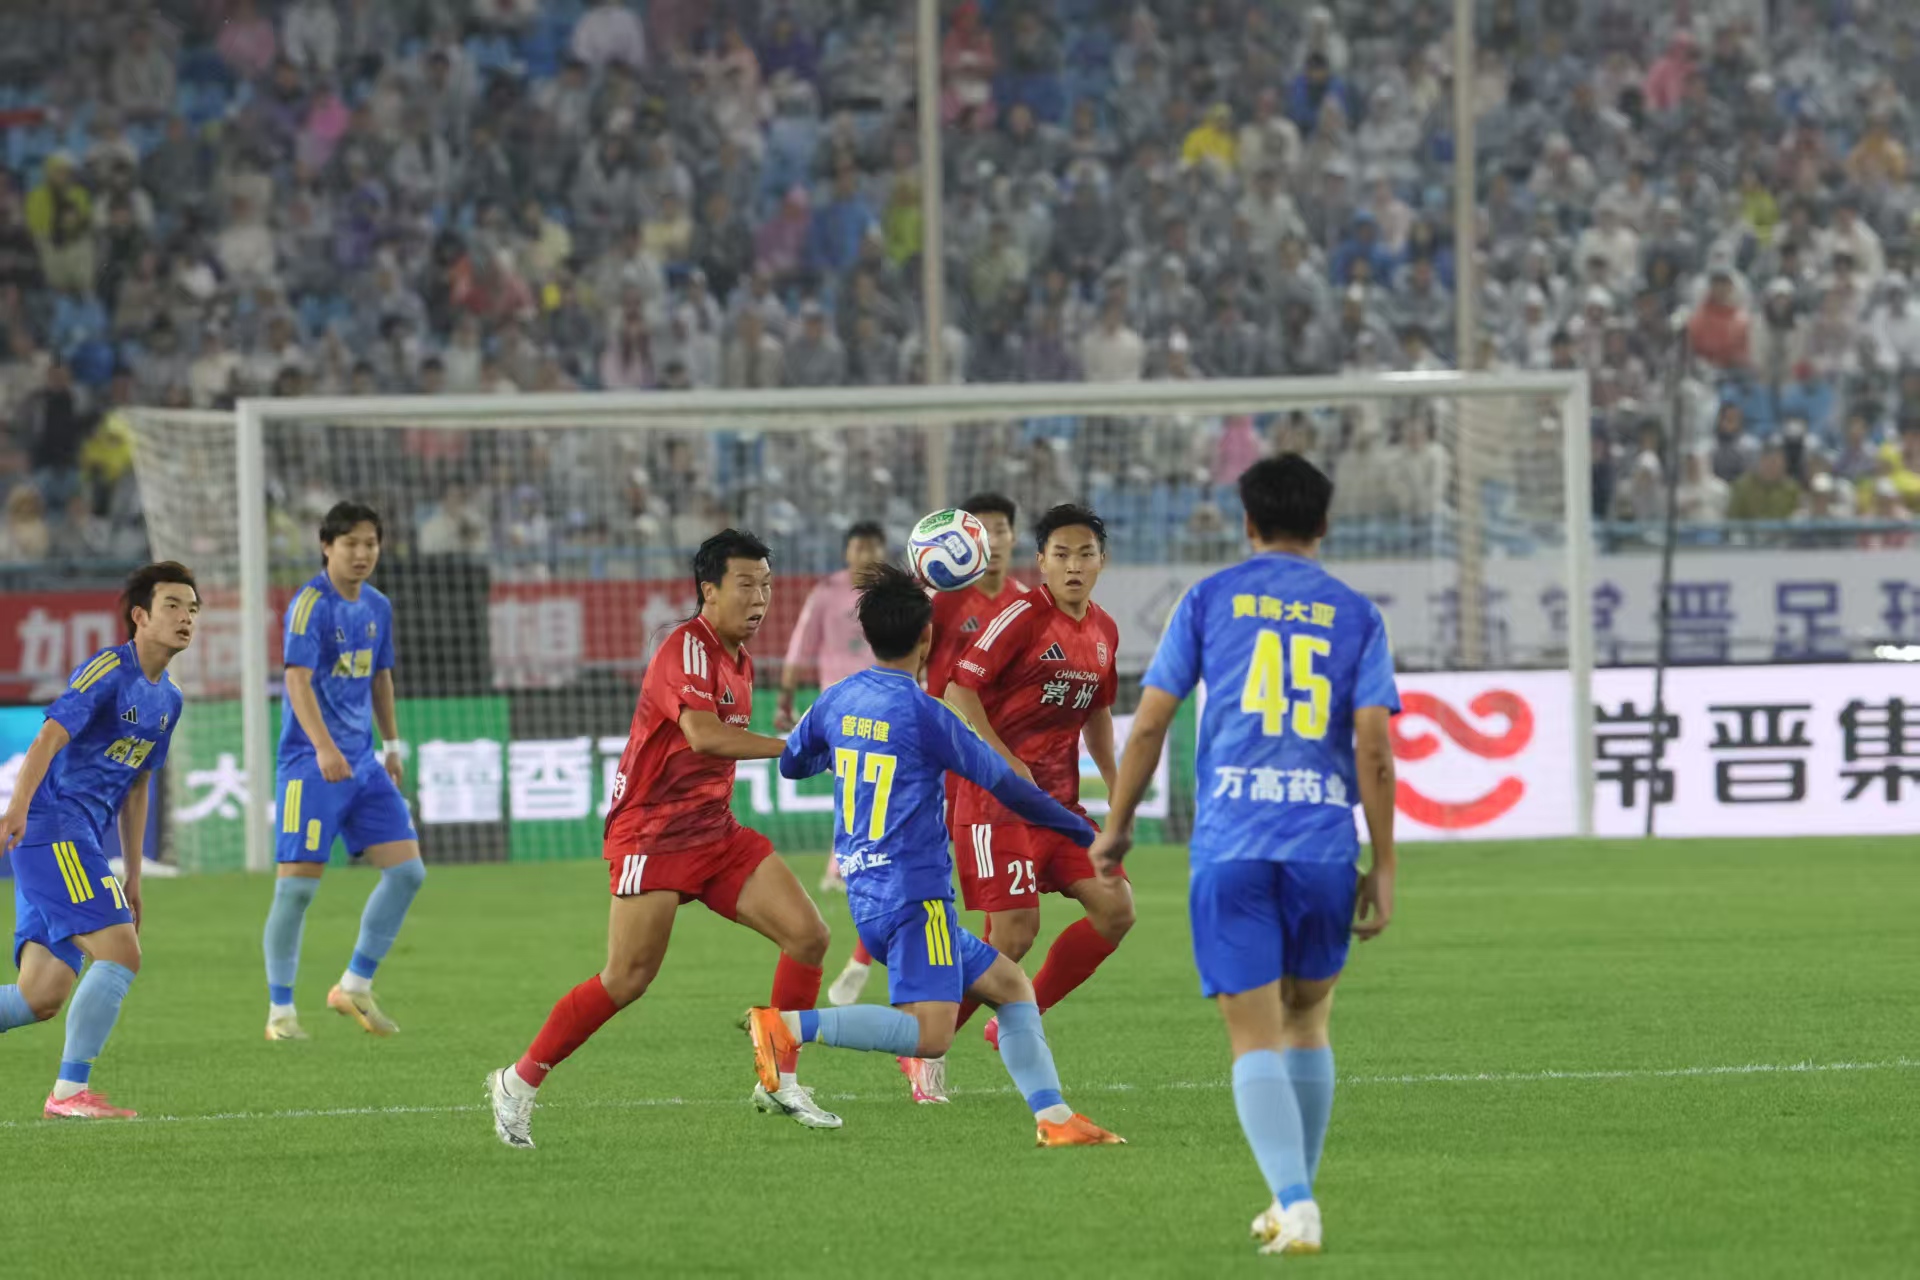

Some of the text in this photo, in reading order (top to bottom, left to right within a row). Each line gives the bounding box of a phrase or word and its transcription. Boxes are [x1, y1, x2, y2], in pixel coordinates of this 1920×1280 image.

[1054, 669, 1100, 681] CHANGZHOU
[1240, 628, 1331, 741] 45
[1040, 680, 1099, 709] 常州
[841, 714, 890, 742] 管明健
[1594, 697, 1920, 808] 常晋集
[834, 747, 897, 841] 77
[1213, 765, 1349, 808] 万高药业
[305, 818, 322, 851] 9
[1007, 860, 1036, 895] 25
